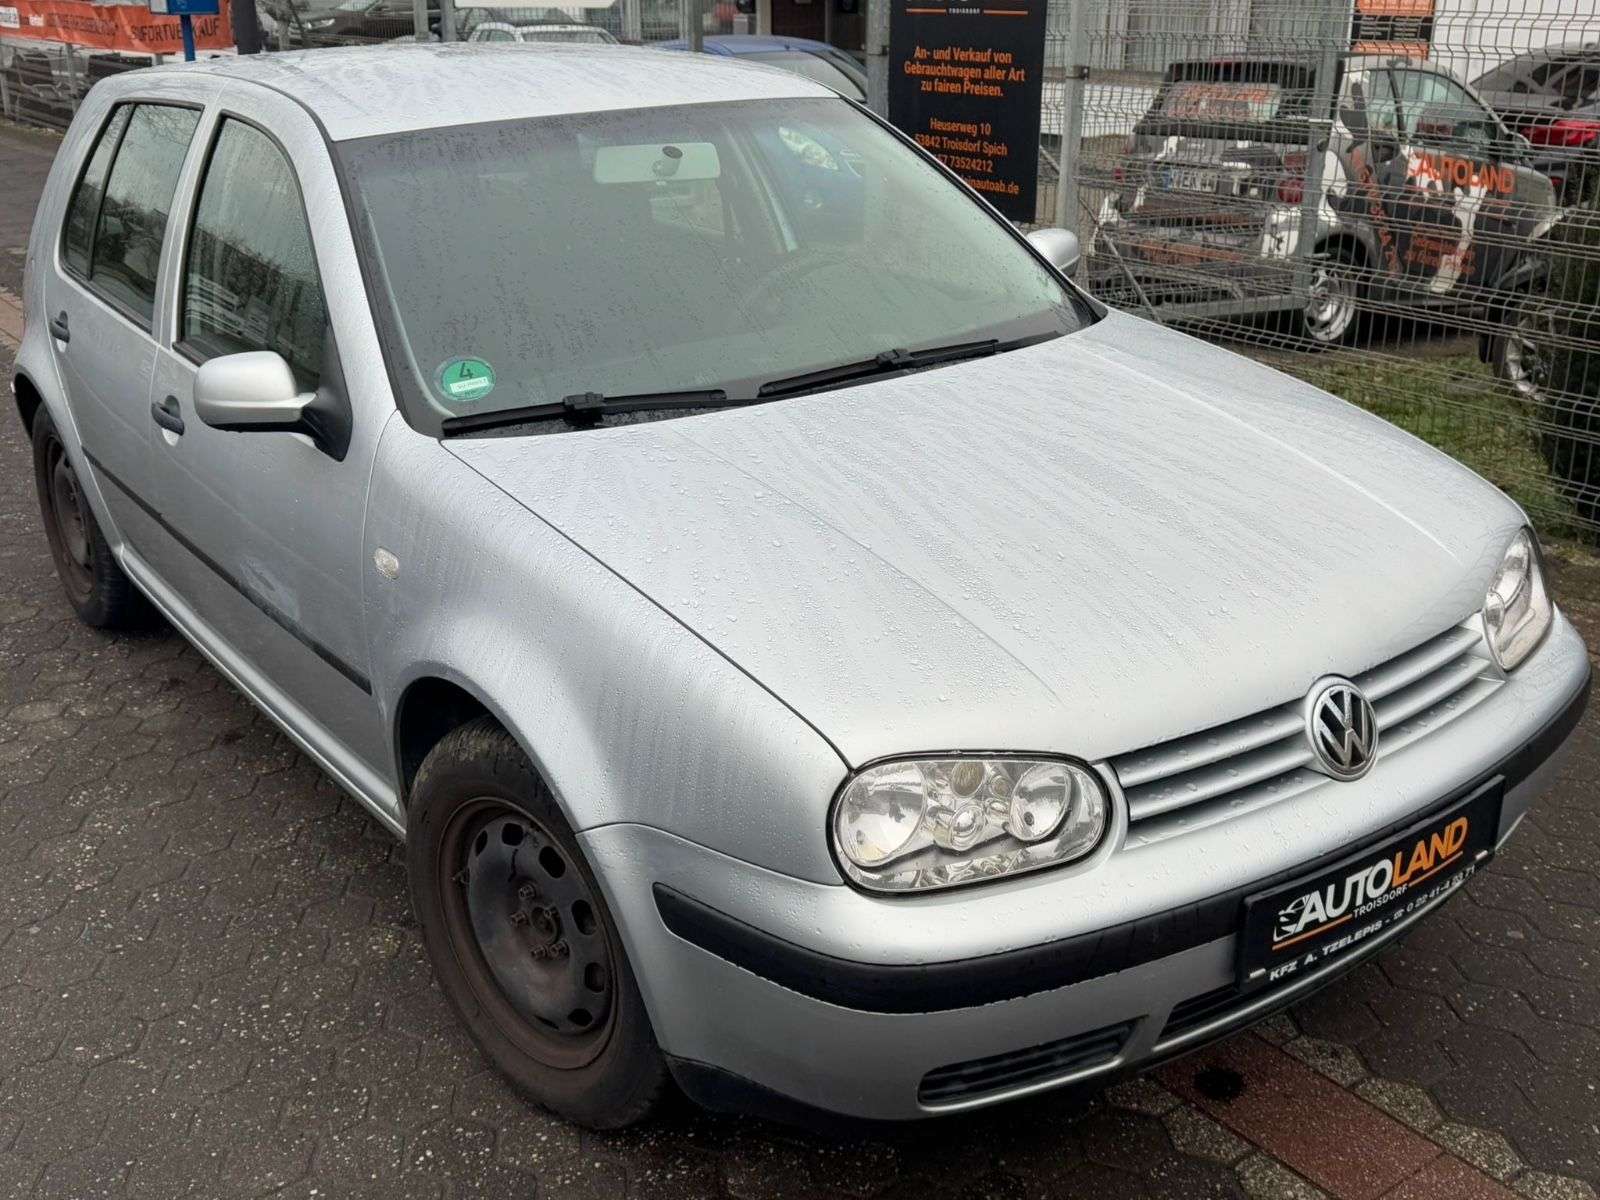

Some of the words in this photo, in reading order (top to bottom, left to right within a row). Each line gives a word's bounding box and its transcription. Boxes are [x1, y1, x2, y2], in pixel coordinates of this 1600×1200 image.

[914, 46, 930, 59] An-
[933, 47, 951, 60] und
[953, 47, 991, 62] Verkauf
[993, 51, 1012, 63] von
[904, 61, 981, 80] Gebrauchtwagen
[984, 66, 1006, 80] aller
[1008, 67, 1025, 82] Art
[921, 81, 932, 91] zu
[934, 79, 960, 93] fairen
[963, 81, 1004, 97] Preisen.
[930, 117, 977, 136] Heuserweg
[980, 123, 991, 136] 10
[943, 137, 980, 152] Troisdorf
[983, 141, 1008, 157] Spich
[1415, 153, 1516, 194] AUTOLAND
[459, 362, 474, 379] 4
[1293, 816, 1468, 934] AUTOLAND
[1353, 884, 1408, 919] TROISDORF
[1269, 960, 1299, 981] KFZ
[1303, 952, 1318, 966] A.
[1322, 919, 1383, 956] TZELEPIS
